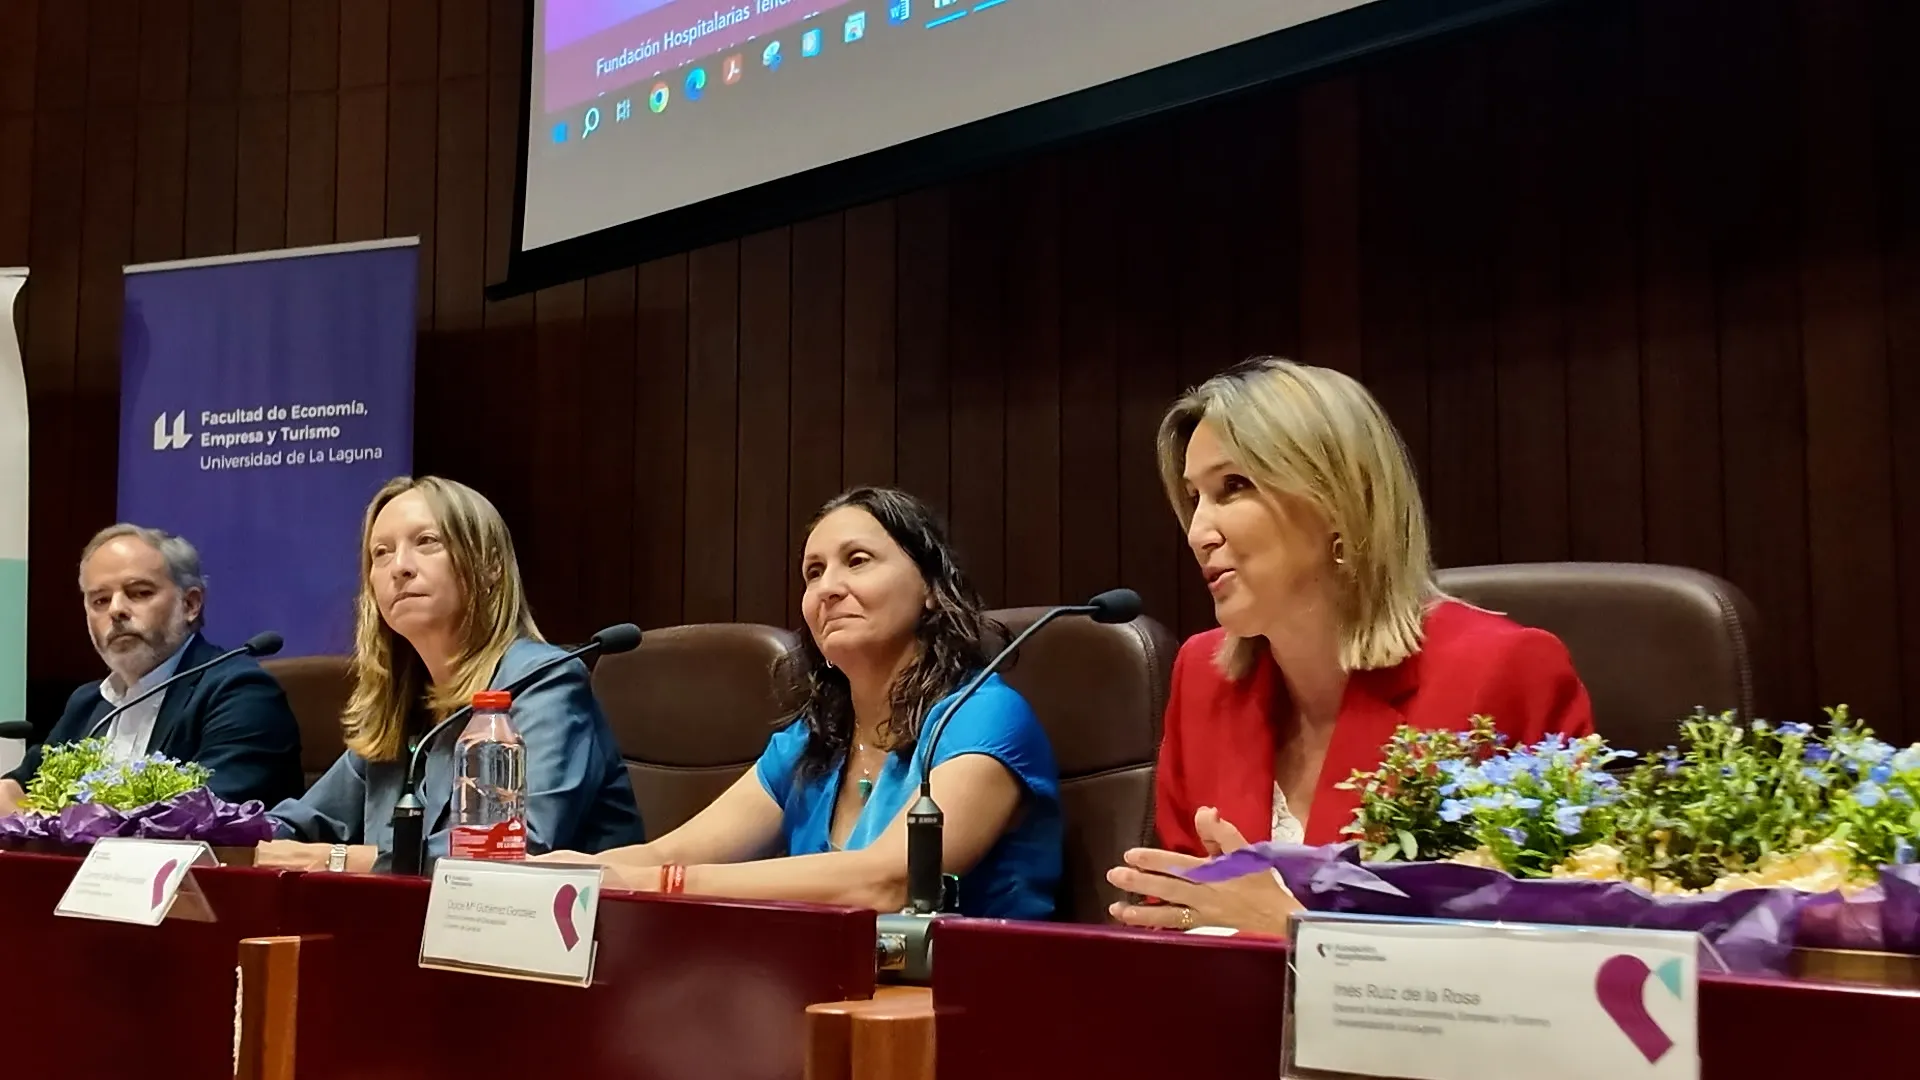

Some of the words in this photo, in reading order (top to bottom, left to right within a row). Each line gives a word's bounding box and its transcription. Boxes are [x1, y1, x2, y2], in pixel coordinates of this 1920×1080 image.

[596, 39, 661, 76] Fundación
[663, 5, 751, 51] Hospitalarias
[756, 0, 793, 14] Tene
[201, 406, 263, 427] Facultad
[267, 406, 287, 421] de
[291, 400, 369, 420] Economía,
[201, 428, 264, 449] Empresa
[266, 430, 277, 446] y
[280, 424, 341, 442] Turismo
[200, 451, 282, 470] Universidad
[286, 450, 305, 465] de
[309, 449, 325, 463] La
[329, 446, 383, 464] Laguna
[1366, 983, 1398, 1001] Ruiz
[1402, 987, 1421, 1002] de
[1442, 988, 1482, 1007] Rosa
